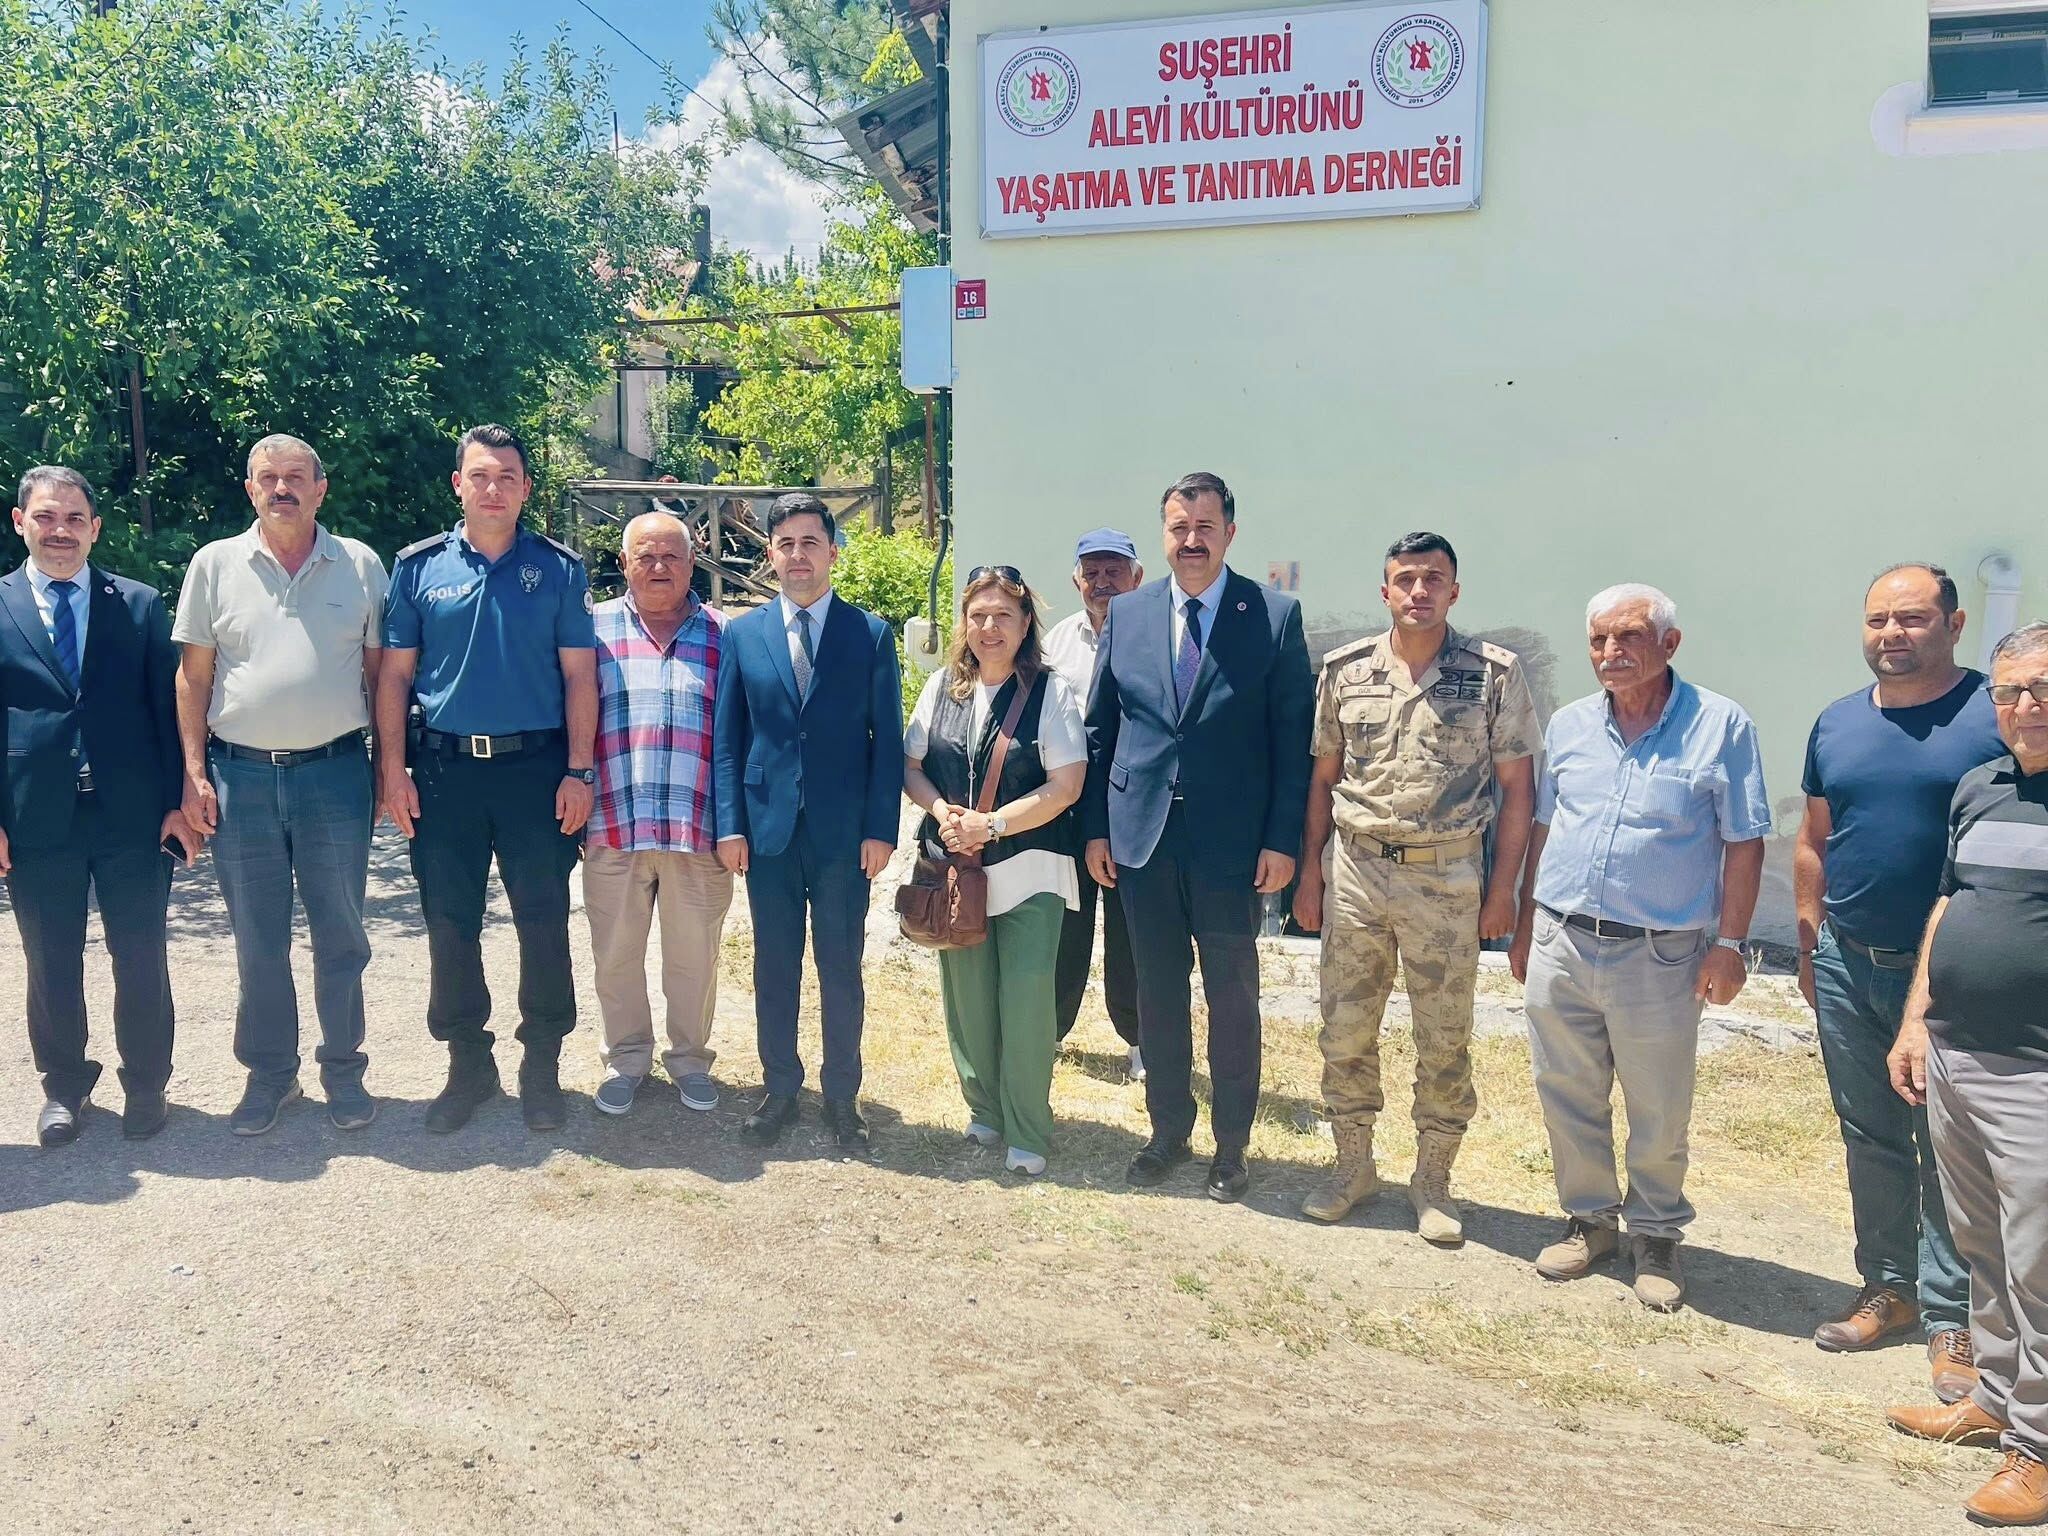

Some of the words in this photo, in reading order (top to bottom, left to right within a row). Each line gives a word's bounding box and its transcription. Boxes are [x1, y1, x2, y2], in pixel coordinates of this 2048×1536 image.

[1158, 22, 1291, 89] SUŞEHRİ
[1445, 28, 1454, 38] VE
[1088, 95, 1171, 148] ALEVİ
[1180, 79, 1364, 142] KÜLTÜRÜNÜ
[996, 168, 1131, 223] YAŞATMA
[1138, 165, 1176, 206] VE
[1183, 156, 1315, 202] TANITMA
[1323, 135, 1462, 194] DERNEĞİ
[963, 291, 978, 305] 16
